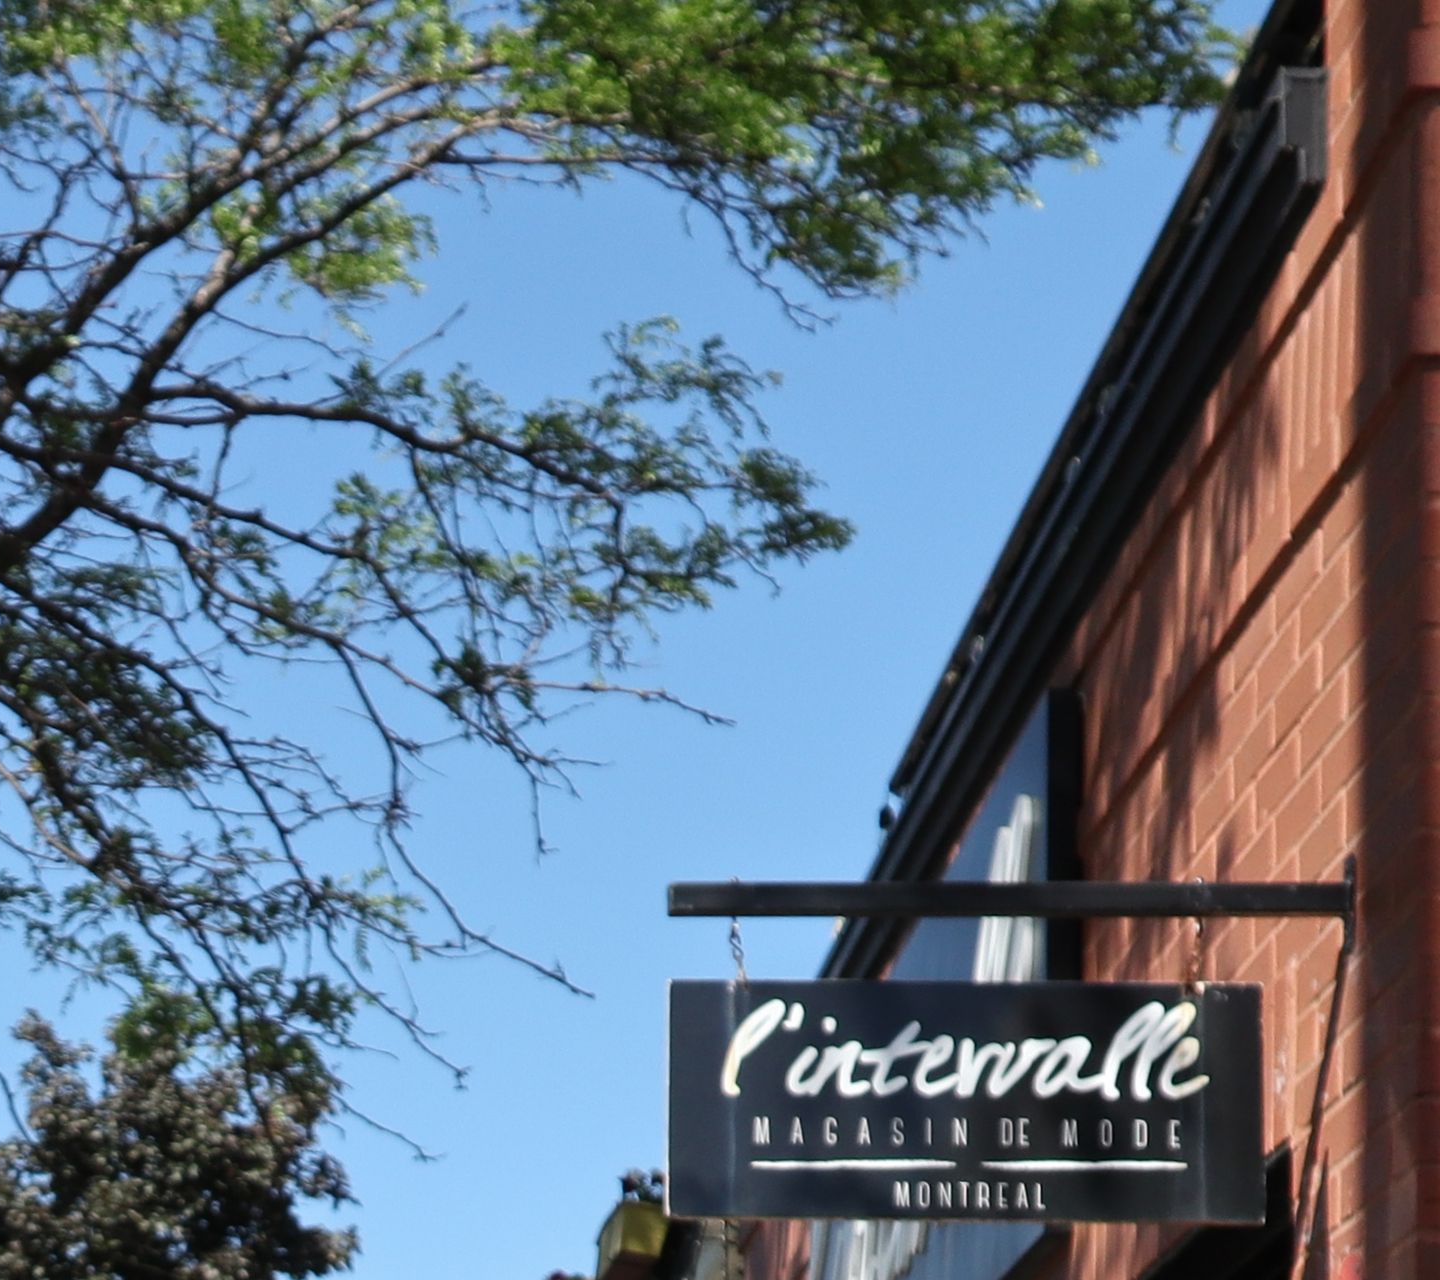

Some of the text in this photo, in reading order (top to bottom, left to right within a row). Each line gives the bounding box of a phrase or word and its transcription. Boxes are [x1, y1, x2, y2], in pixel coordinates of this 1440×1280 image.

[721, 999, 1210, 1100] l'intervalle
[752, 1116, 1182, 1149] MAGASIN DE MODE
[893, 1181, 1046, 1210] MONTREAL
